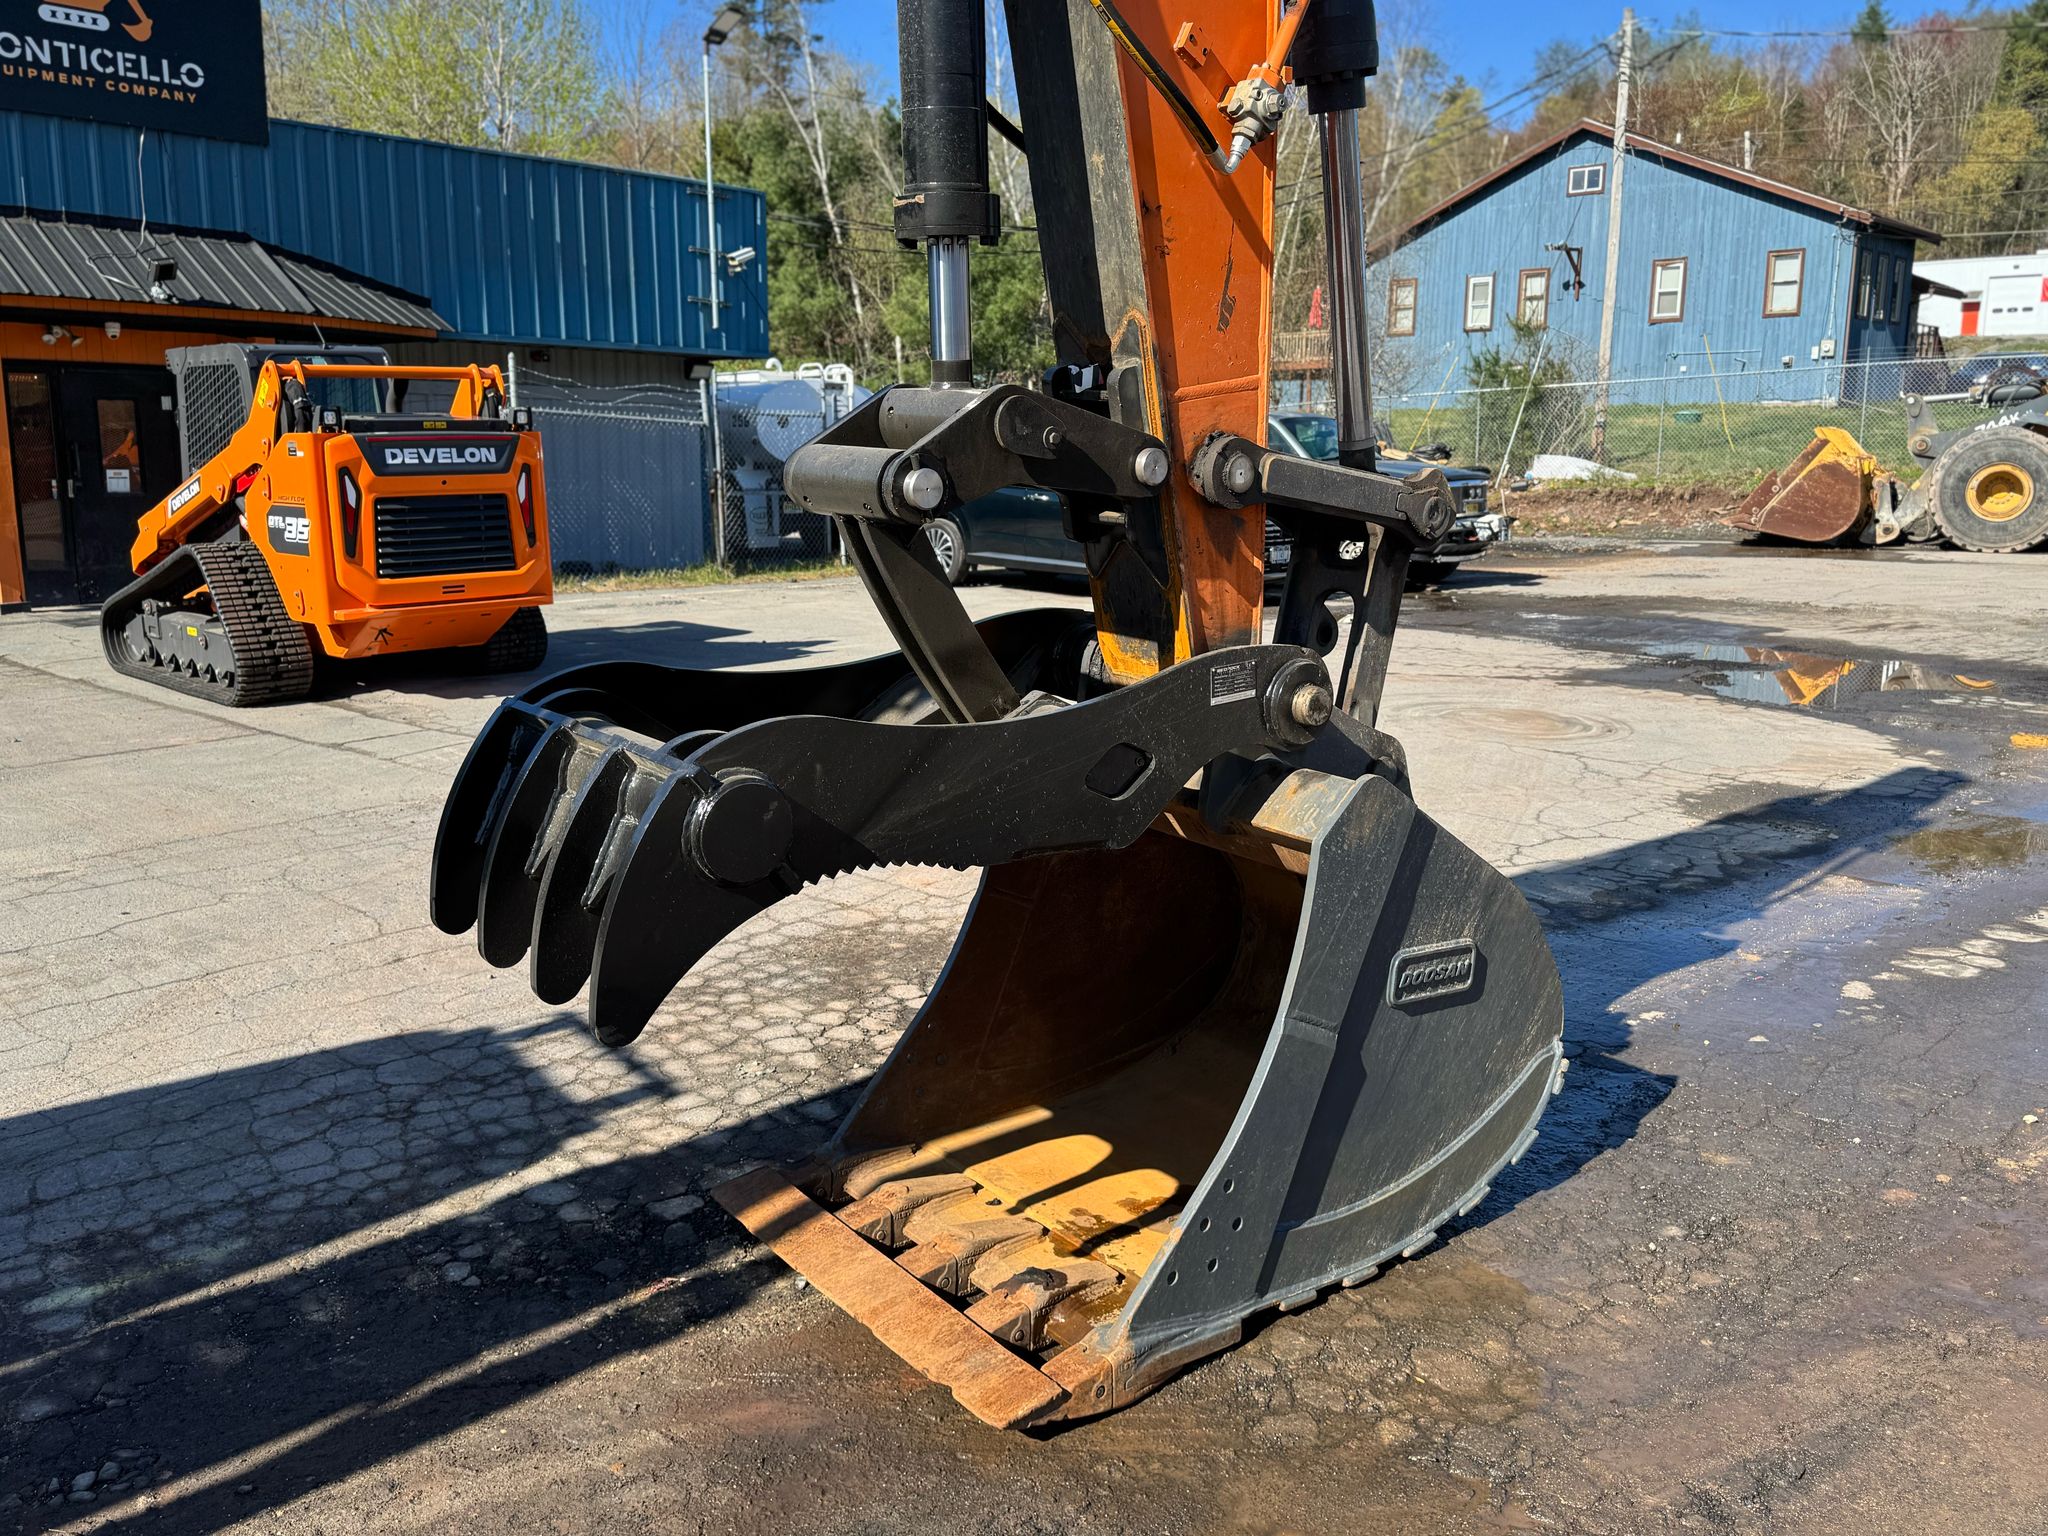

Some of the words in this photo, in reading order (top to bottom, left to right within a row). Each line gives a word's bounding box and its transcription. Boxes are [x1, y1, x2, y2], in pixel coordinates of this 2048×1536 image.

[3, 64, 96, 88] UIPMENT
[105, 79, 196, 104] COMPANY
[384, 447, 497, 464] DEVELON
[1399, 959, 1472, 988] DOOSAN
